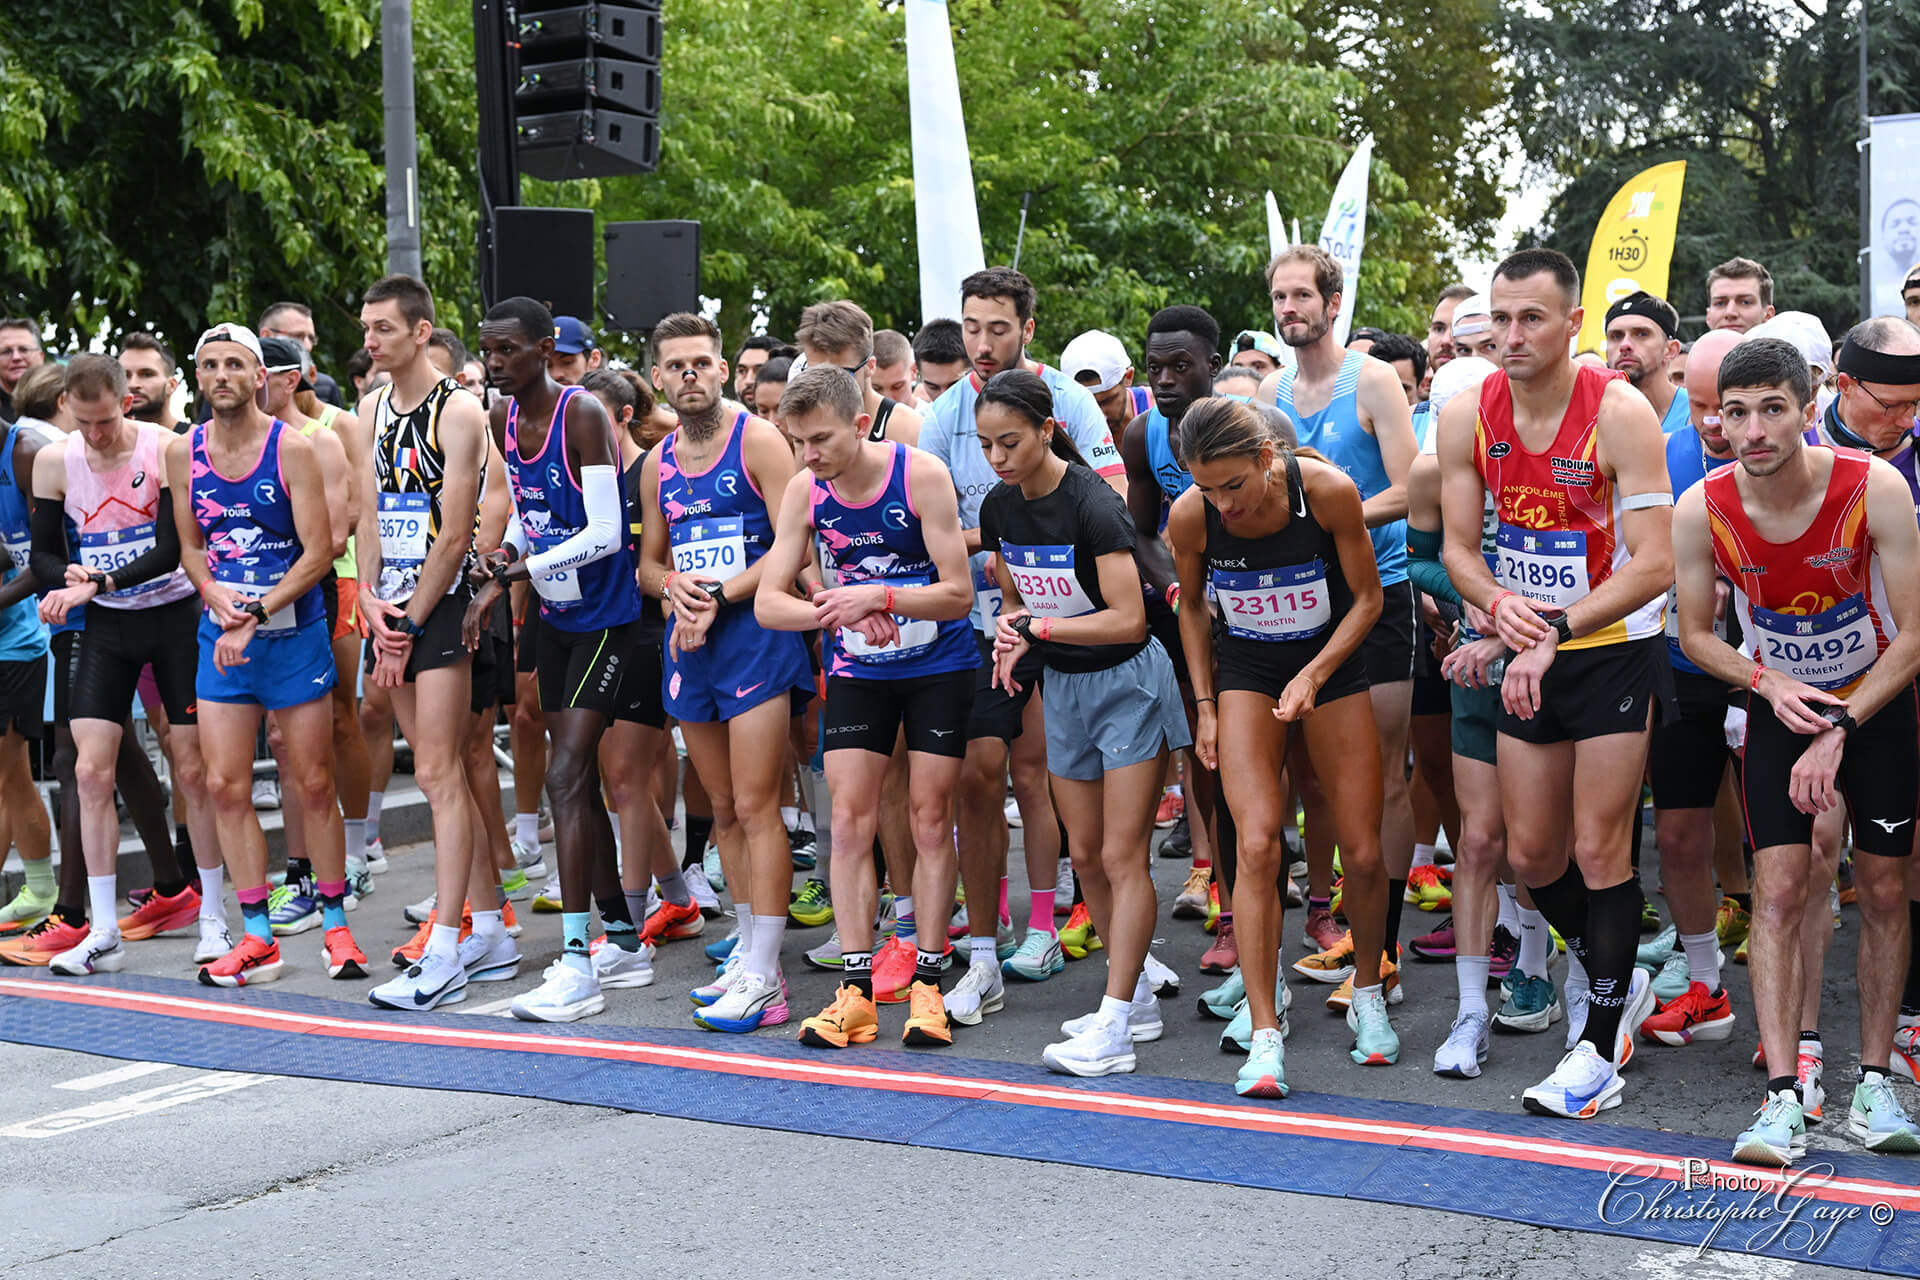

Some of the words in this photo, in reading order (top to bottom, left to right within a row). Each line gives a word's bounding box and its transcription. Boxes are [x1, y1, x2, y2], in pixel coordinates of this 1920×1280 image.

[1609, 247, 1640, 261] 1H30
[1552, 457, 1594, 471] STADIUM
[222, 507, 252, 518] TOURS
[684, 502, 712, 516] TOURS
[258, 539, 294, 551] ATHLE
[851, 534, 885, 547] TOURS
[678, 544, 735, 573] 23570
[1506, 557, 1576, 588] 21896
[1013, 572, 1073, 597] 23310
[1230, 590, 1318, 615] 23115
[1521, 589, 1556, 603] BAPTISTE
[1257, 616, 1296, 627] KRISTIN
[1767, 630, 1865, 662] 20492
[1792, 662, 1845, 676] CLÉMENT
